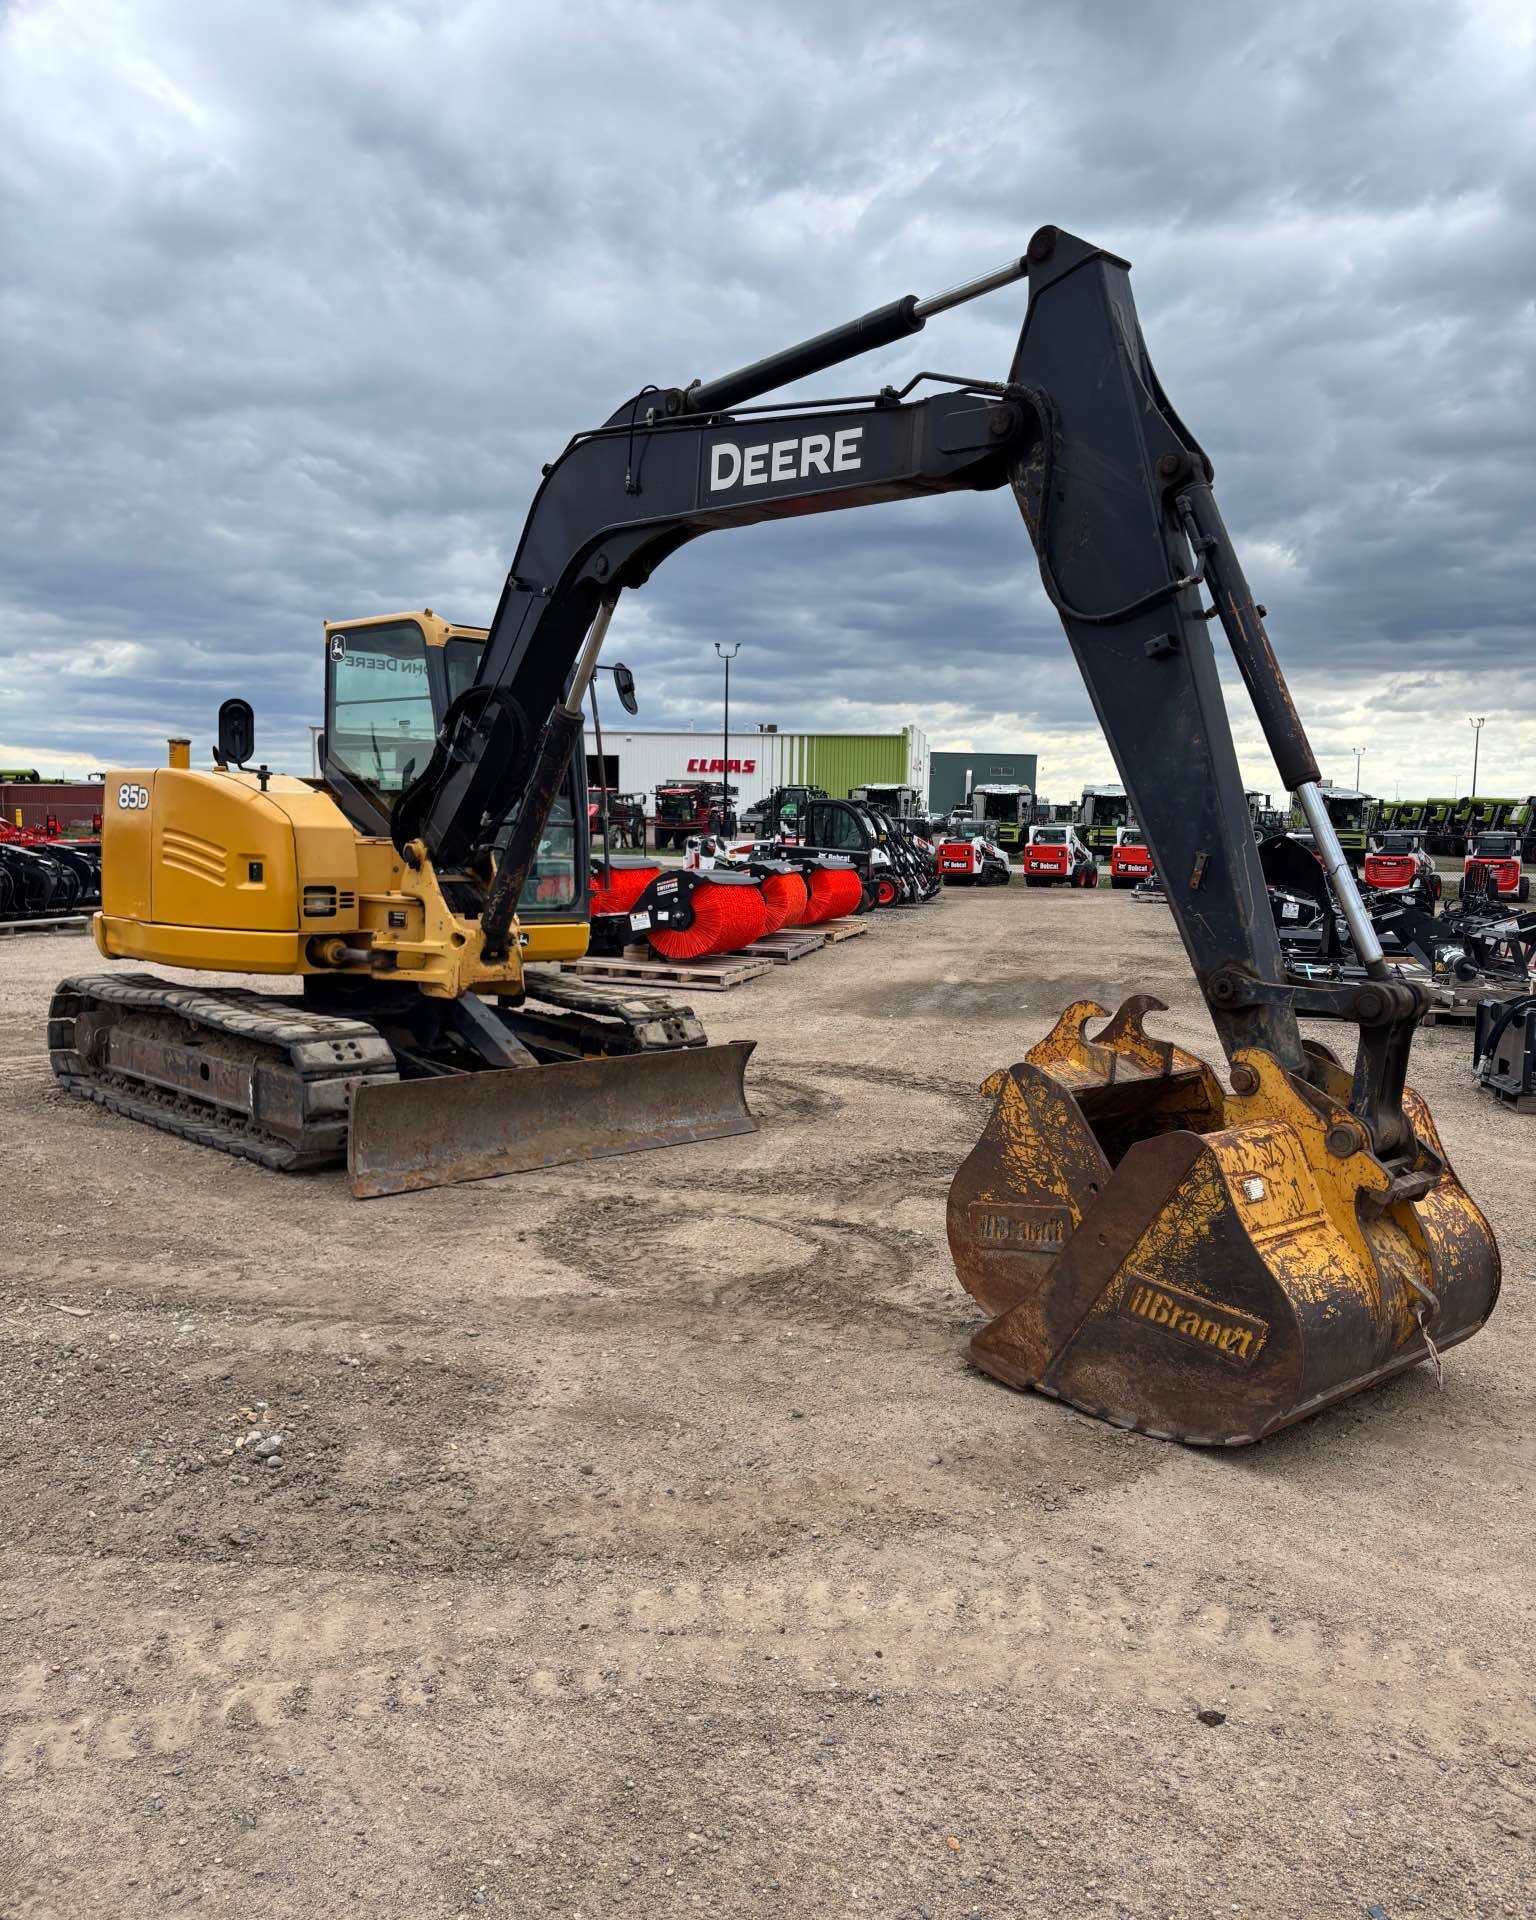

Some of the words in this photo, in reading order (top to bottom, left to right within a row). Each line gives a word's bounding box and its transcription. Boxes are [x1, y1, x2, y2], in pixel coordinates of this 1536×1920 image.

[711, 427, 863, 492] DEERE
[687, 759, 756, 773] CLAAS
[118, 783, 149, 809] 85D
